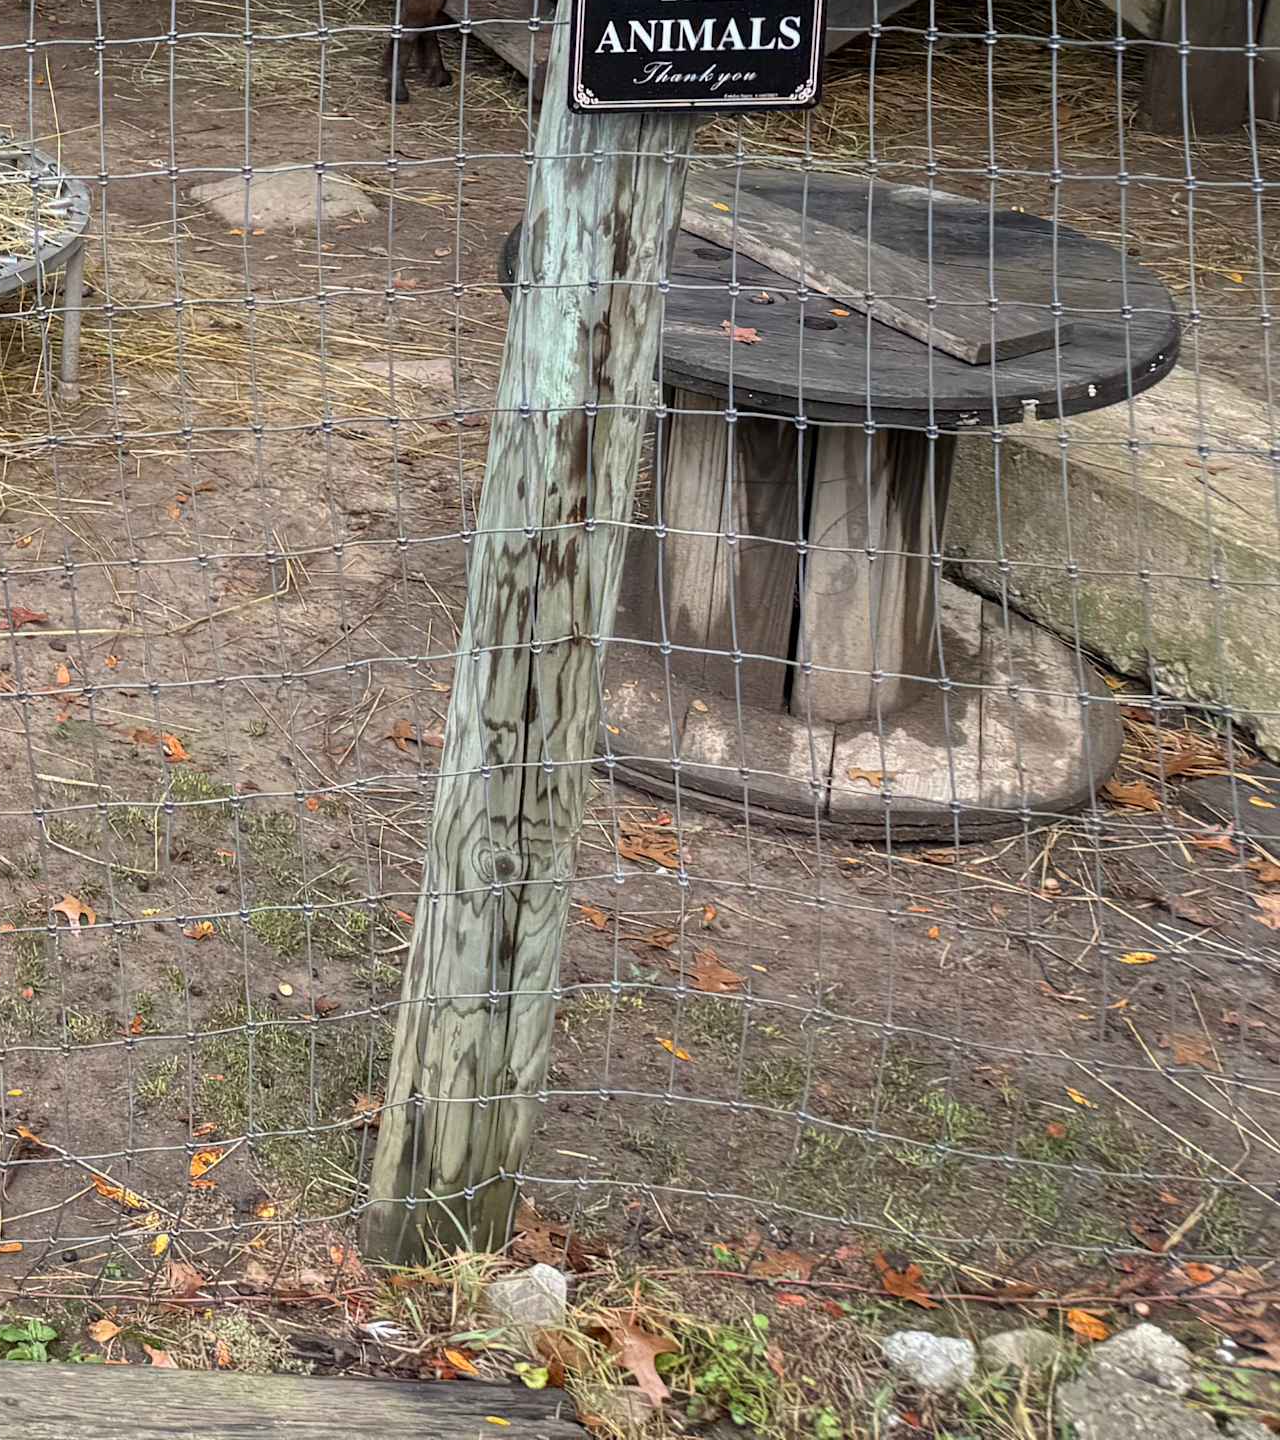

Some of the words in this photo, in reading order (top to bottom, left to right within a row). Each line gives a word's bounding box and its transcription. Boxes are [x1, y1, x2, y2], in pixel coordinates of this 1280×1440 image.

[594, 15, 802, 54] ANIMALS
[632, 60, 716, 86] Thank
[708, 70, 758, 91] you
